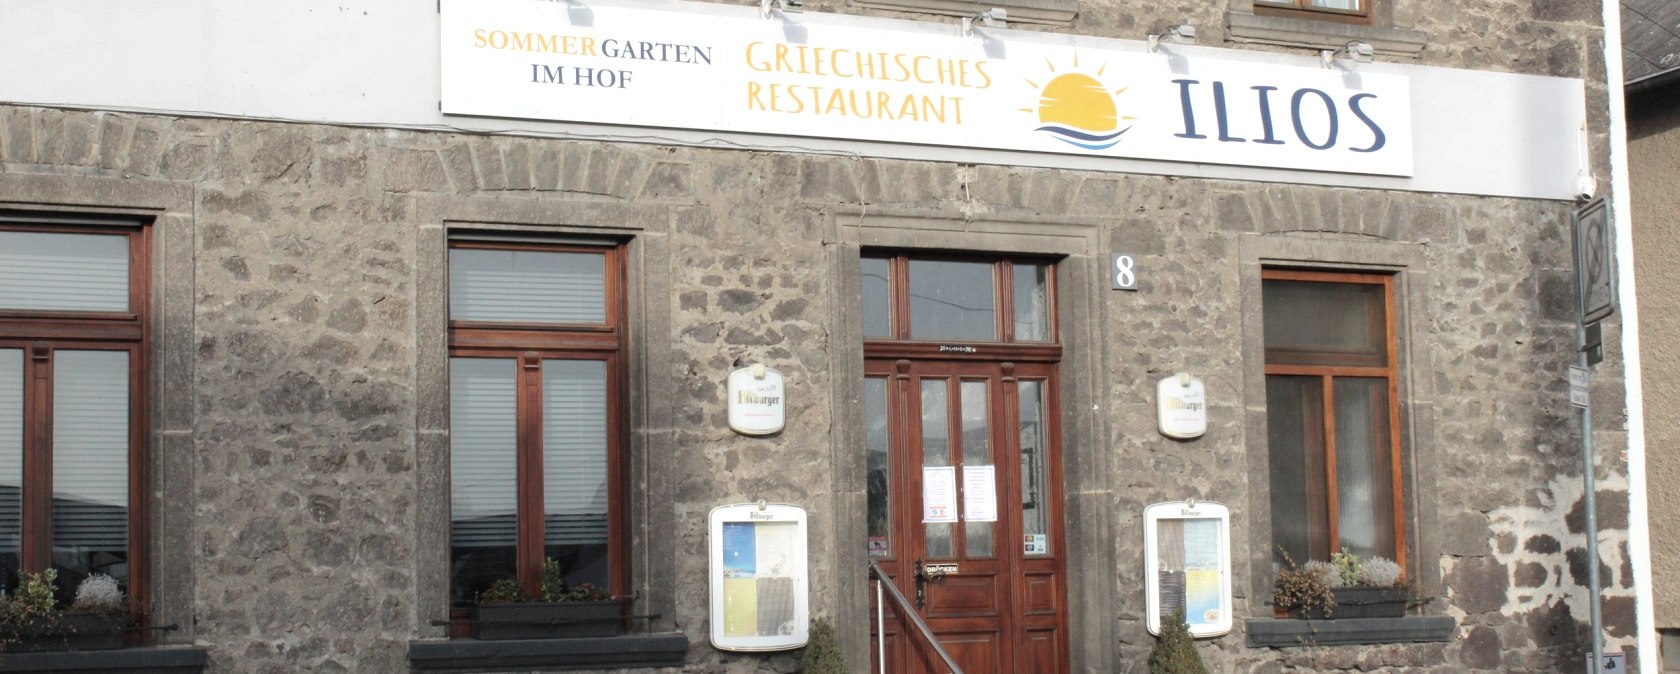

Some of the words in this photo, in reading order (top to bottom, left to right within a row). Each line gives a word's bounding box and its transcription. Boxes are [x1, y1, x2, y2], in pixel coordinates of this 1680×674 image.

[530, 63, 566, 85] IM
[573, 66, 633, 89] HOF
[745, 41, 992, 89] GRIECHISCHES
[747, 81, 965, 125] RESTAURANT
[1171, 79, 1387, 153] ILIOS
[1116, 255, 1135, 287] 8
[1167, 395, 1203, 412] burger
